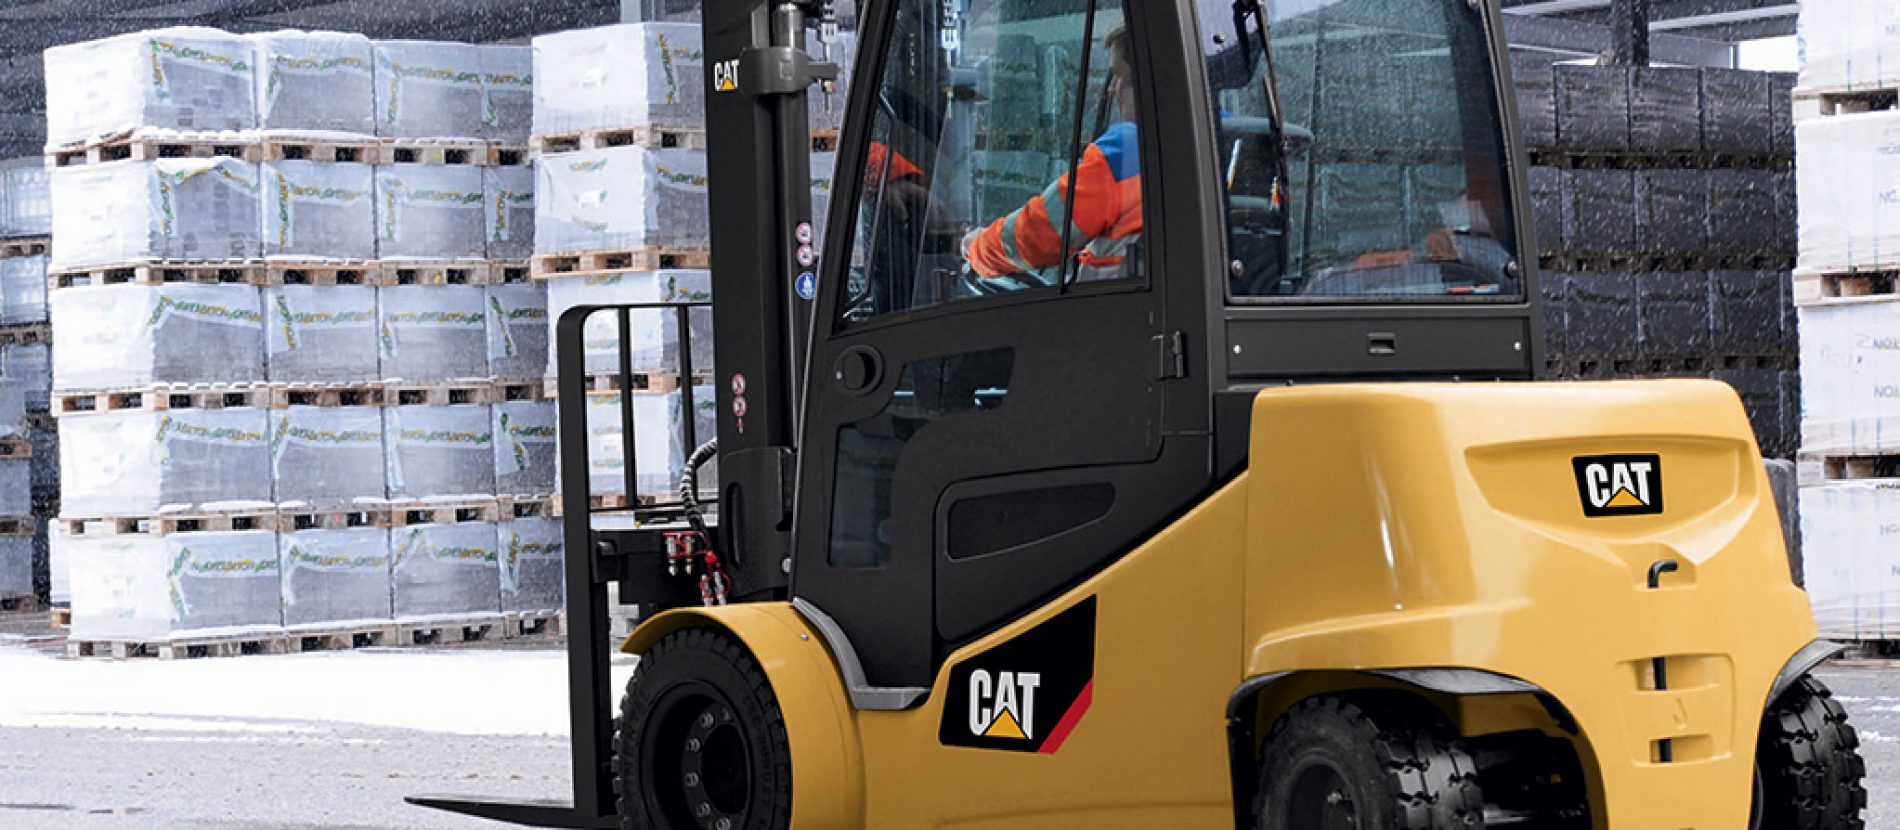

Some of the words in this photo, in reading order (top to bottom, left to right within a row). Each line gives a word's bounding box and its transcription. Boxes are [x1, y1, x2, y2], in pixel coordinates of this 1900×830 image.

[714, 59, 739, 91] CAT
[1585, 462, 1651, 507] CAT
[969, 668, 1041, 740] CAT
